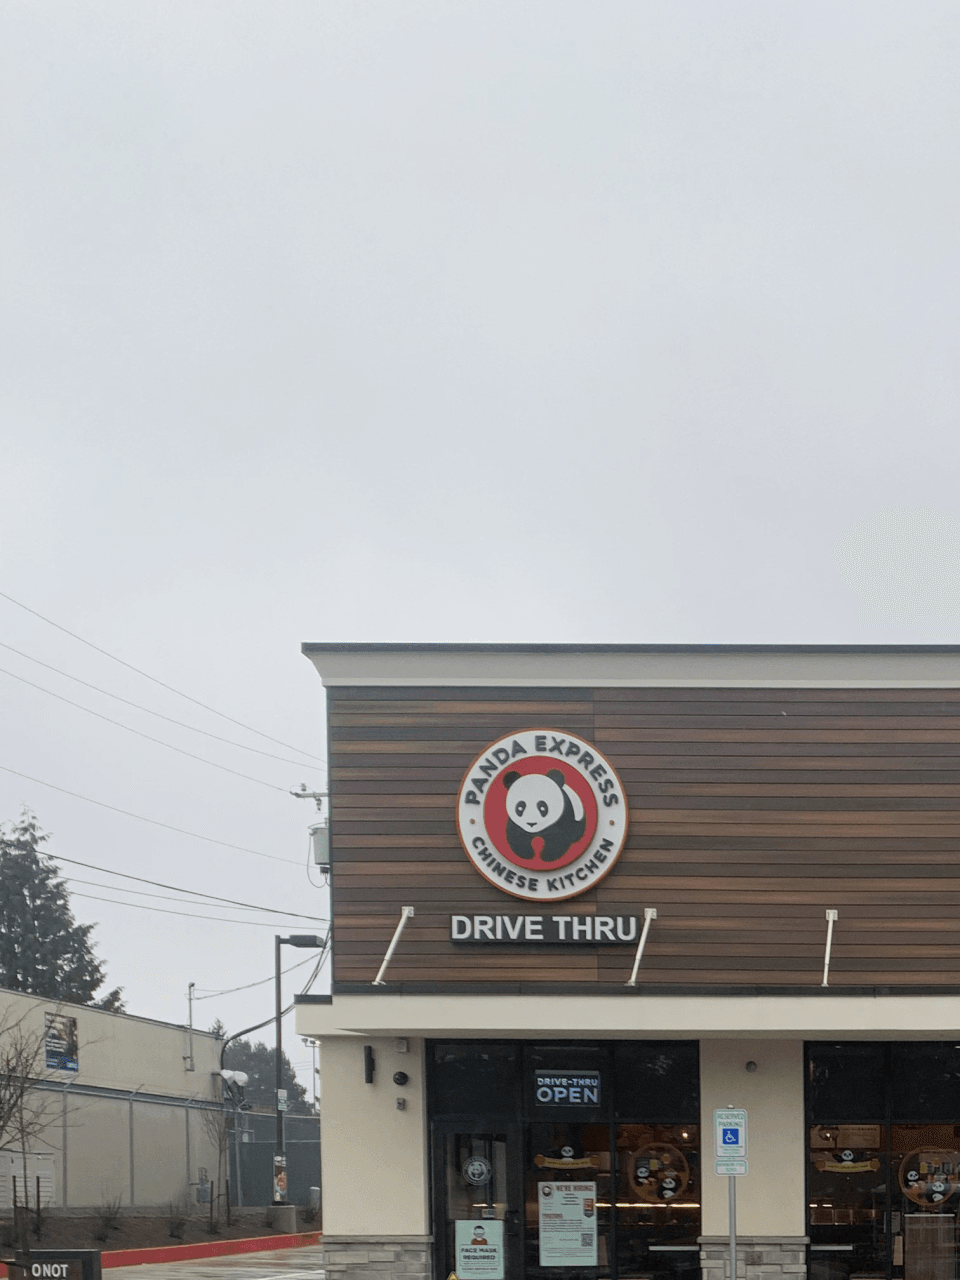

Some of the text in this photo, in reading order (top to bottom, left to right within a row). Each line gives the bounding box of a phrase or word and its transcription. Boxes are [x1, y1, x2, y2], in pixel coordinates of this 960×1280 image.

[465, 735, 619, 807] PANDA EXPRESS
[472, 836, 614, 892] CHINESE KITCHEN
[452, 915, 637, 941] DRIVE THRU
[537, 1077, 598, 1086] DRIVE-THRU
[537, 1087, 598, 1102] OPEN
[43, 1264, 68, 1277] NOT
